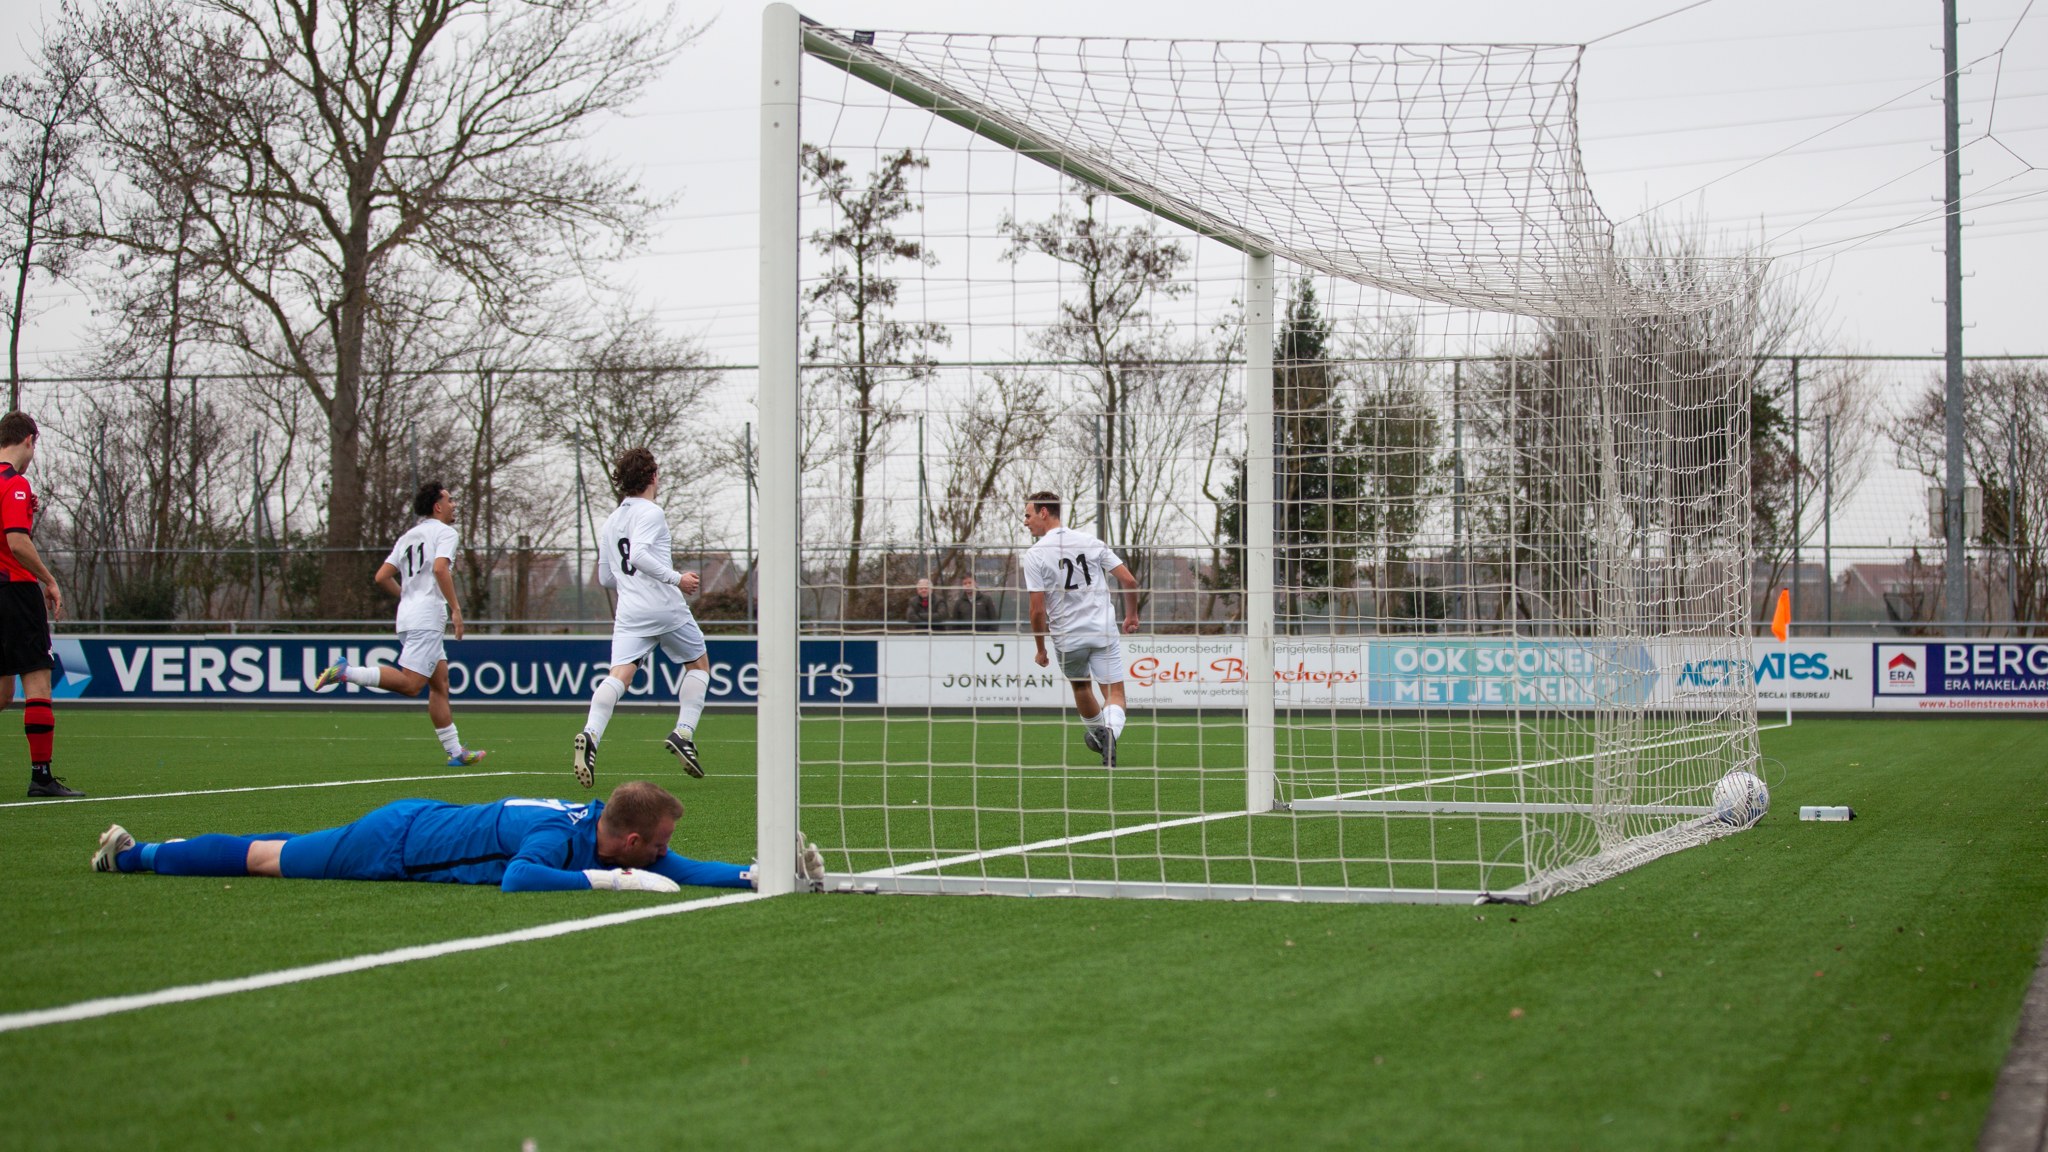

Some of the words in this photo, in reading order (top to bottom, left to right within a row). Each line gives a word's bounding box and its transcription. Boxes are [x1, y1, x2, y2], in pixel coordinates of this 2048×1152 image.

[404, 542, 426, 577] 11
[617, 537, 637, 576] 8
[1058, 554, 1092, 590] 21
[1128, 643, 1232, 655] Stucadoorsbedrijf
[1394, 648, 1467, 673] OOK
[1476, 648, 1606, 673] SCOREN
[942, 673, 1053, 688] JONKMAN
[1129, 657, 1205, 687] Gebr.
[1889, 671, 1915, 681] ERA
[1395, 678, 1461, 702] MET
[1467, 678, 1506, 702] JE
[1944, 680, 1971, 690] ERA
